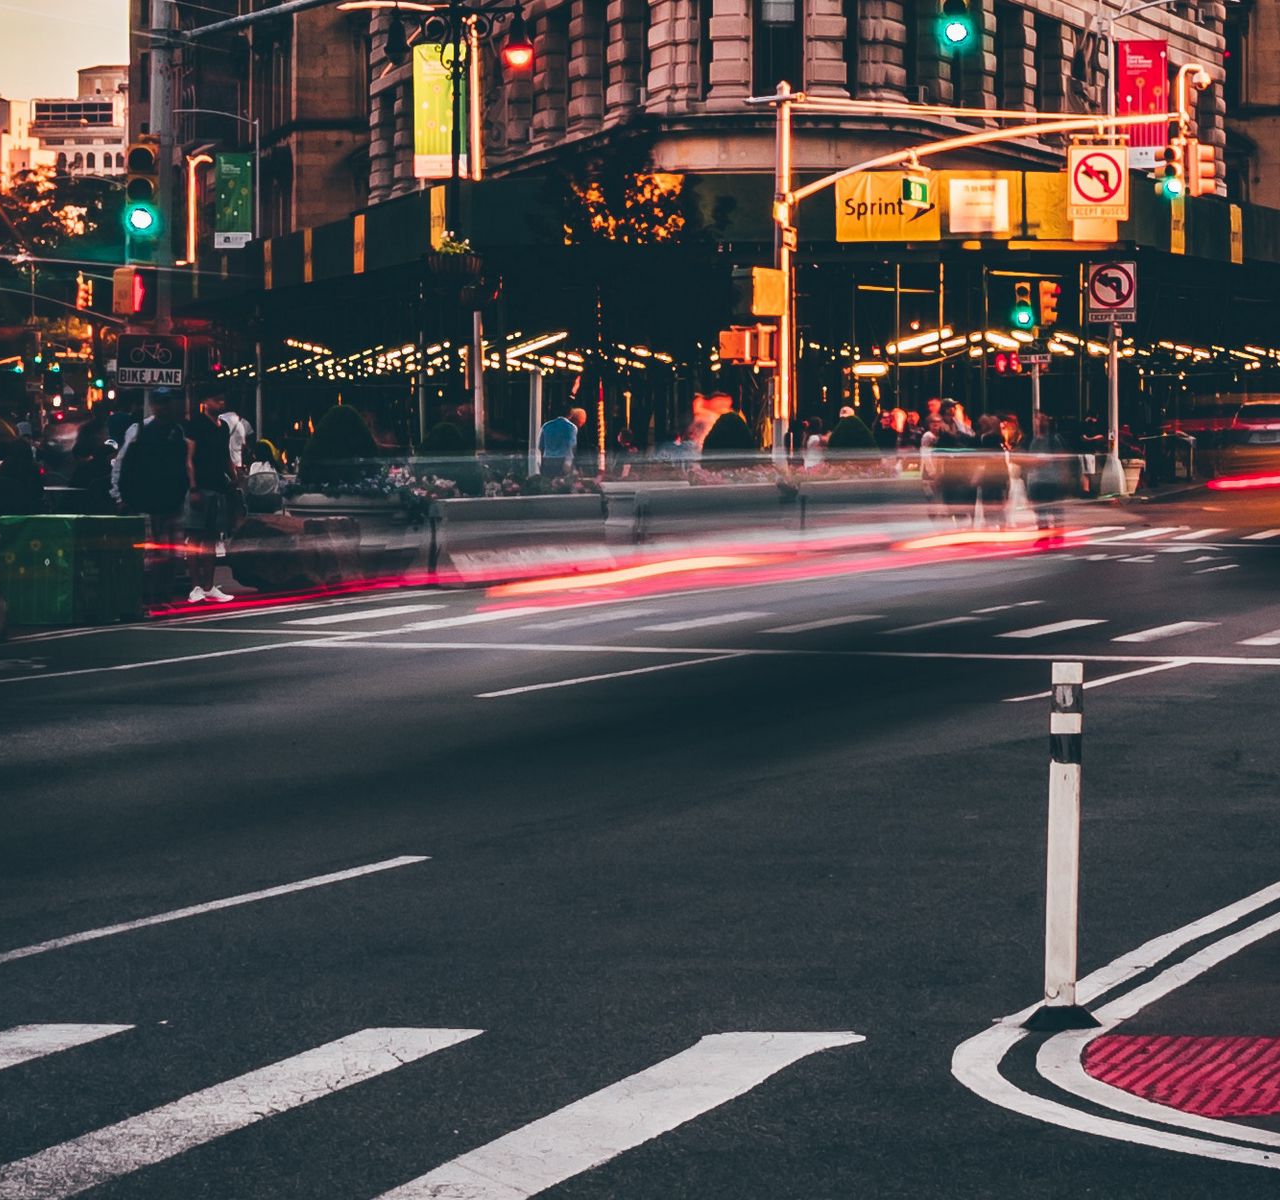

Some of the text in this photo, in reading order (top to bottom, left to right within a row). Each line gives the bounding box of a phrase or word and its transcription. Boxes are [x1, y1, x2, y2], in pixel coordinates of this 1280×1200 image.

[845, 197, 905, 220] Sprint
[1071, 207, 1126, 216] EXCEPT BUSES
[1090, 313, 1133, 321] EXCEPT BUSES
[120, 369, 180, 384] BIKE LANE
